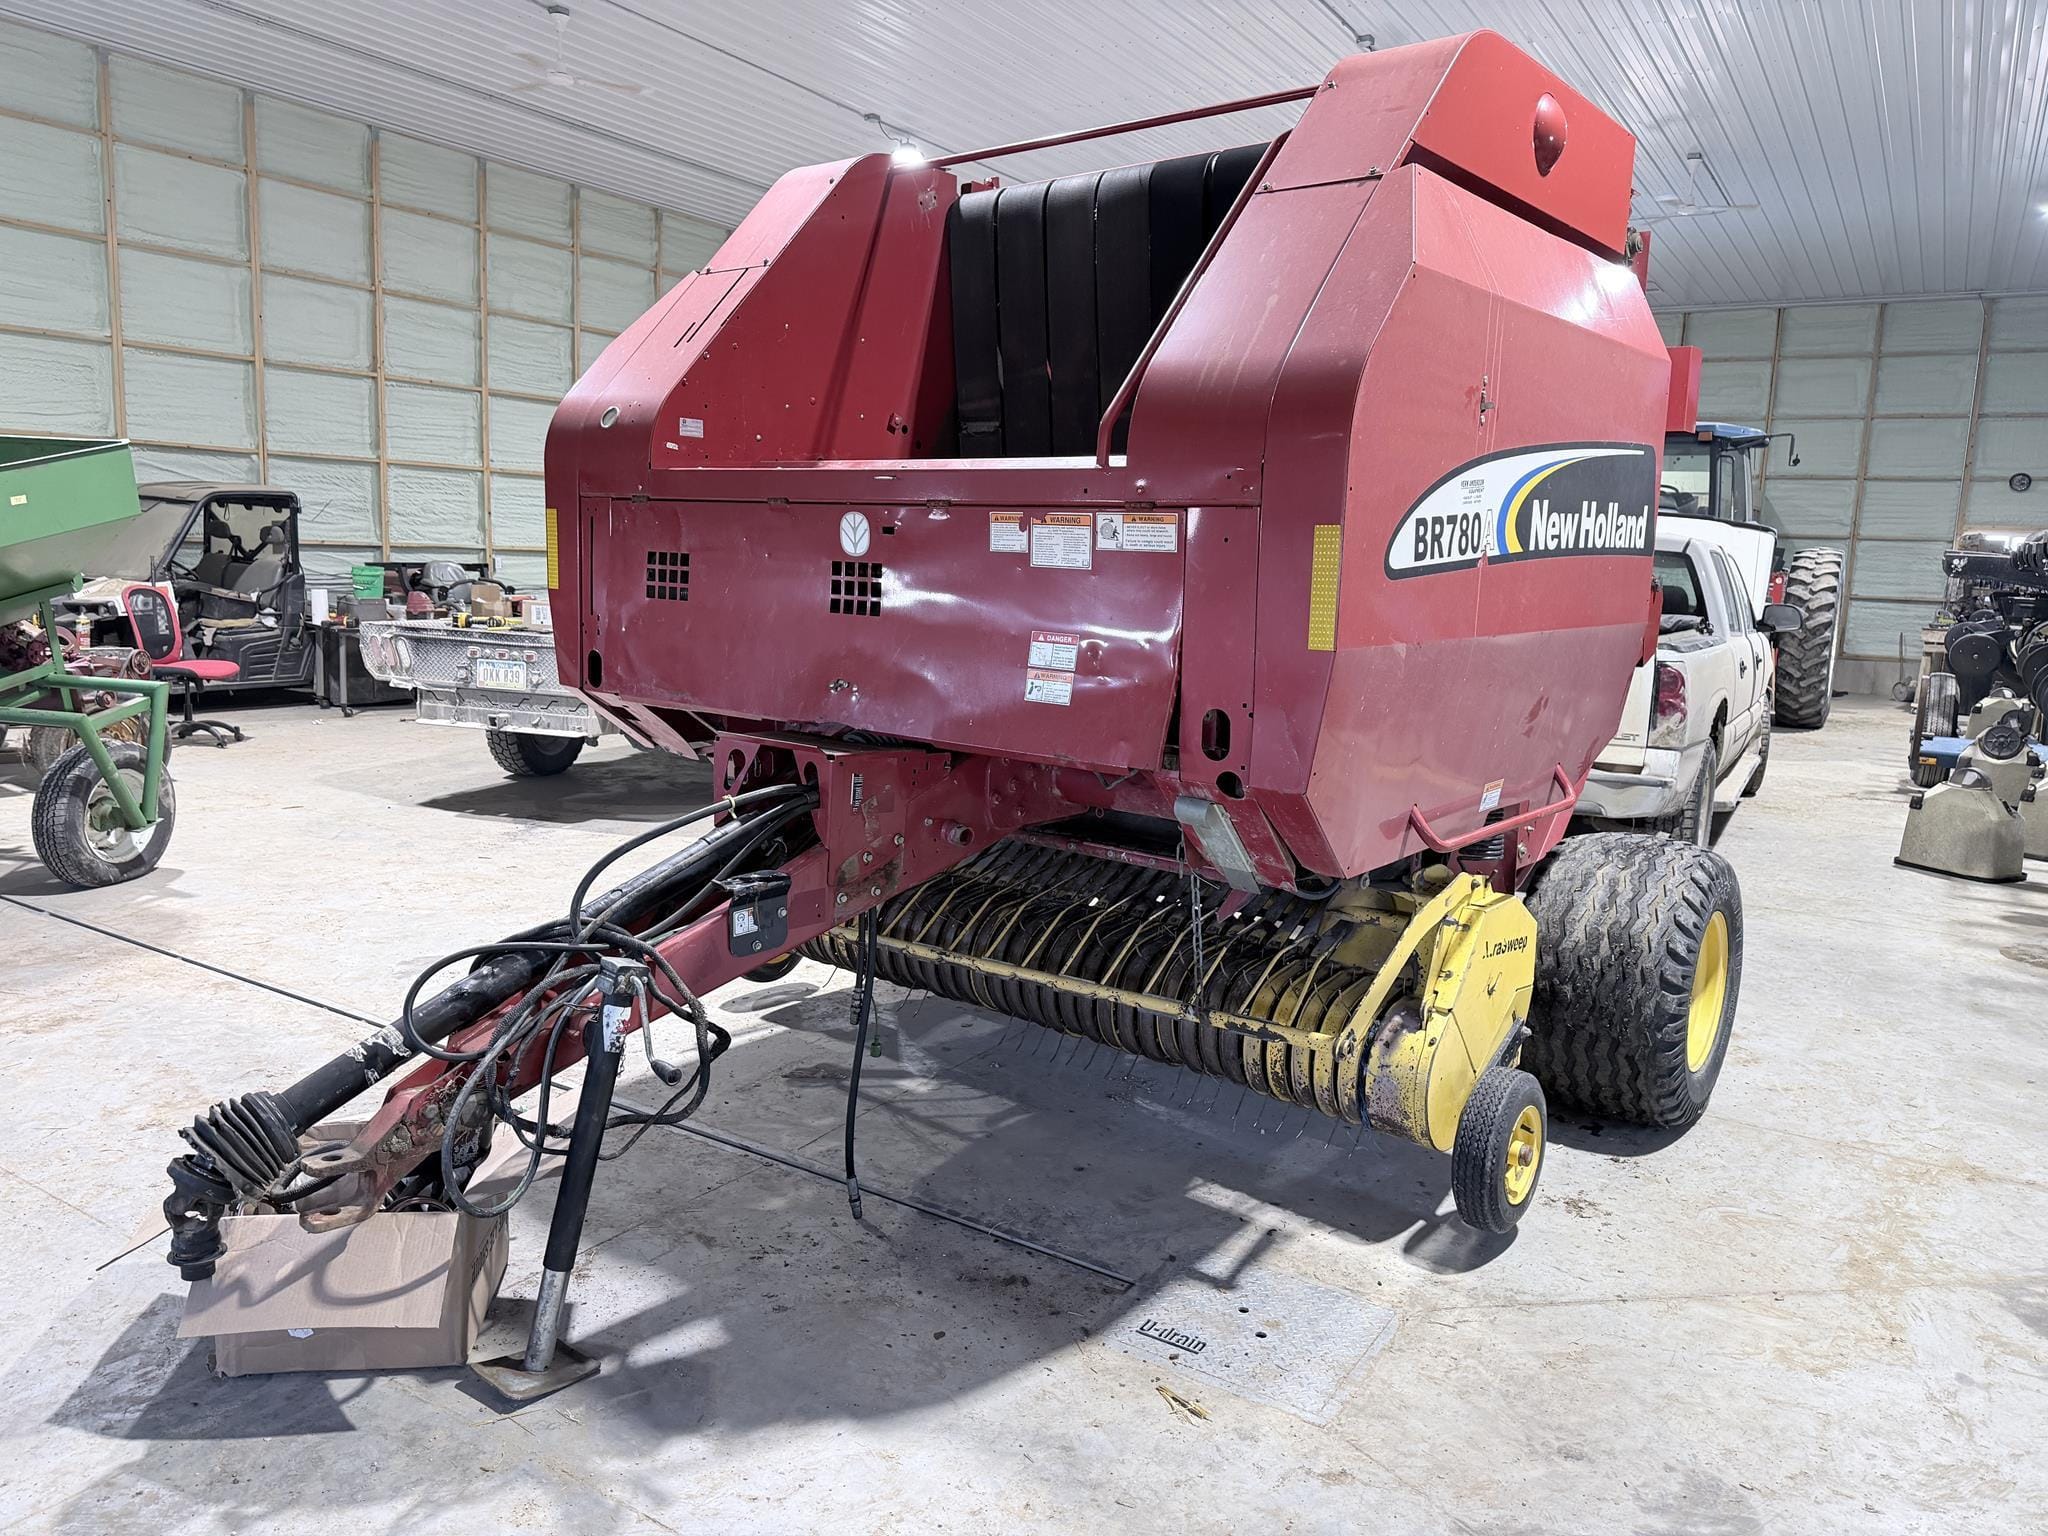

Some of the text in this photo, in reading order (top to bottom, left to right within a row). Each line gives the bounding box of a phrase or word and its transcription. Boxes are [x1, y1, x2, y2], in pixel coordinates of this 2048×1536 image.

[1050, 516, 1081, 524] WARNING
[1529, 499, 1649, 551] New Holland
[1046, 634, 1072, 643] DANGER
[1139, 1319, 1207, 1352] U-drain
